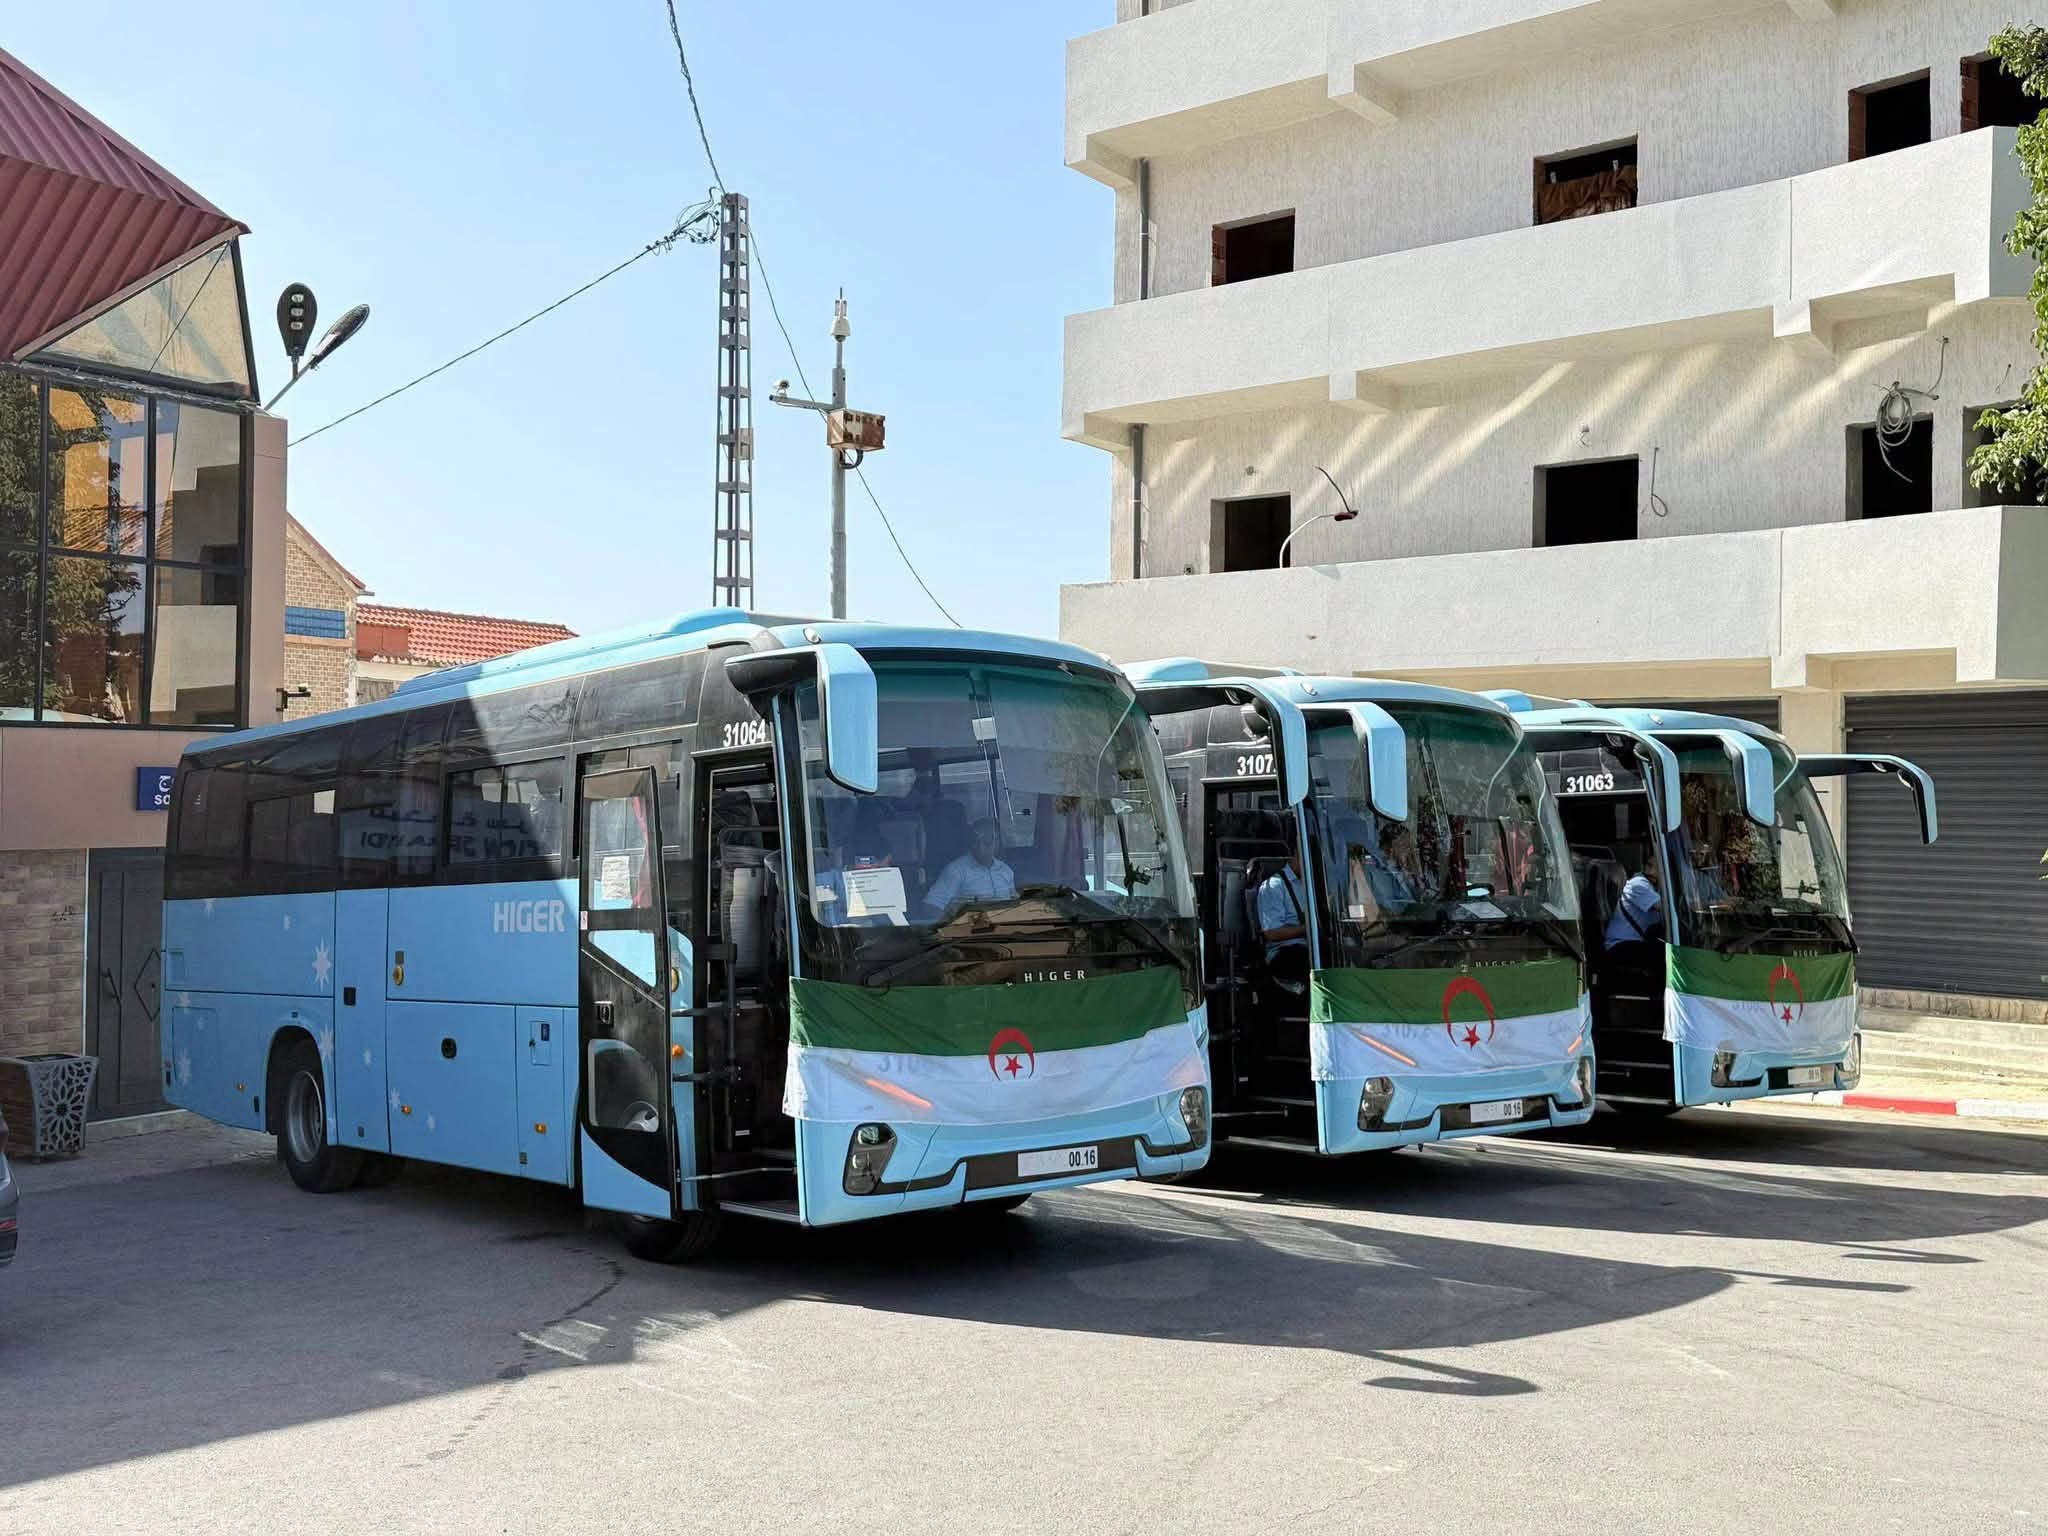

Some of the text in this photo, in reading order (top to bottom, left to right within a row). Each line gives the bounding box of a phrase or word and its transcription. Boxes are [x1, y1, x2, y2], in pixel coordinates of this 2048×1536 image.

[722, 719, 766, 747] 31064
[1237, 753, 1276, 776] 3107
[1566, 773, 1614, 793] 31063
[493, 900, 565, 933] HIGER
[1024, 969, 1086, 983] HIGER
